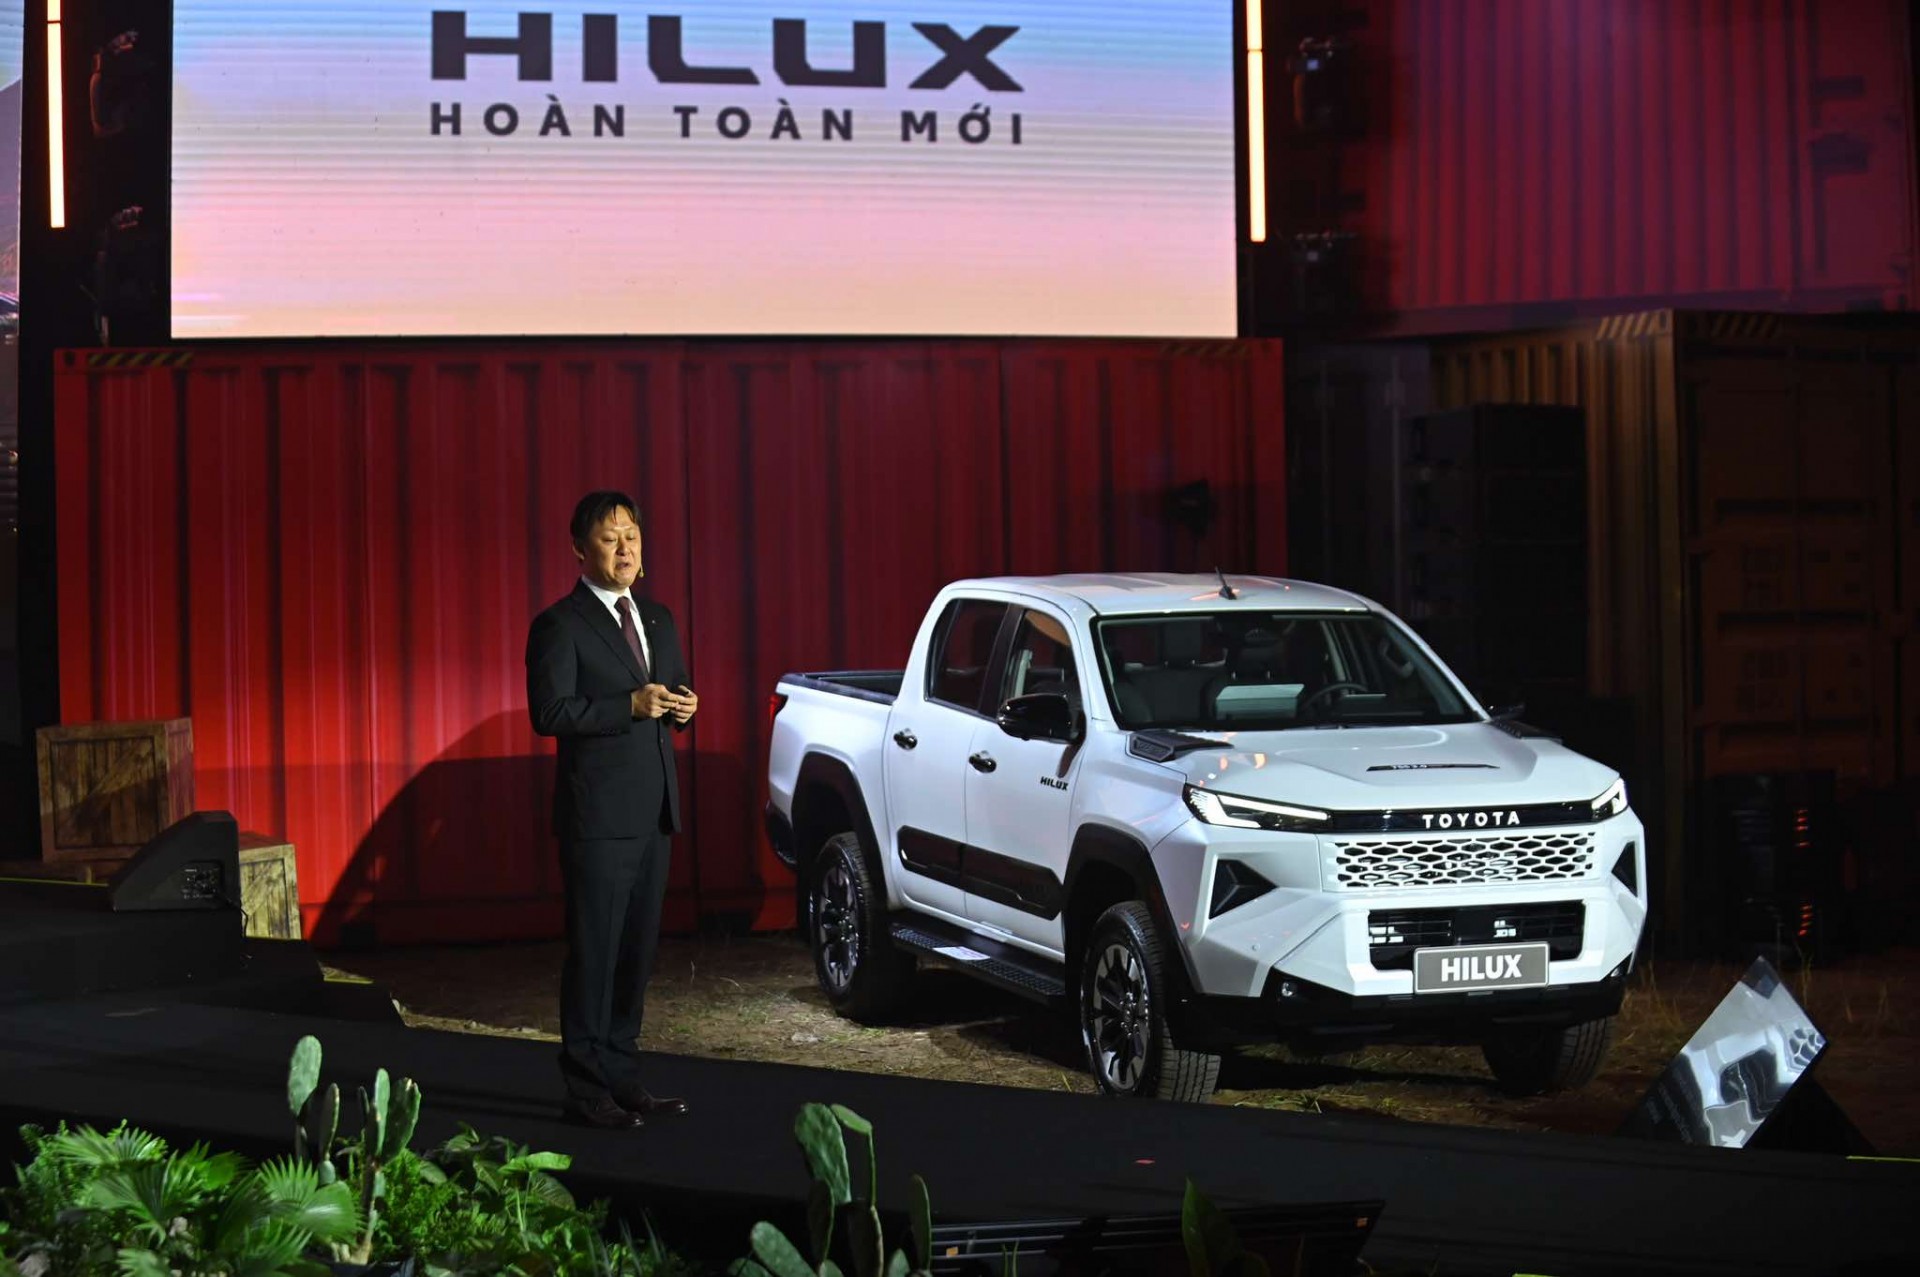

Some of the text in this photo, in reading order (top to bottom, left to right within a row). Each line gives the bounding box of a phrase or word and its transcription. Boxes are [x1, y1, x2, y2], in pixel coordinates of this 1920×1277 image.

[431, 10, 1025, 93] HILUX
[430, 94, 1022, 145] HOÀN TOÀN MỚI
[1040, 776, 1068, 791] HILUX
[1422, 811, 1520, 829] TOYOTA
[1440, 954, 1522, 982] HILUX
